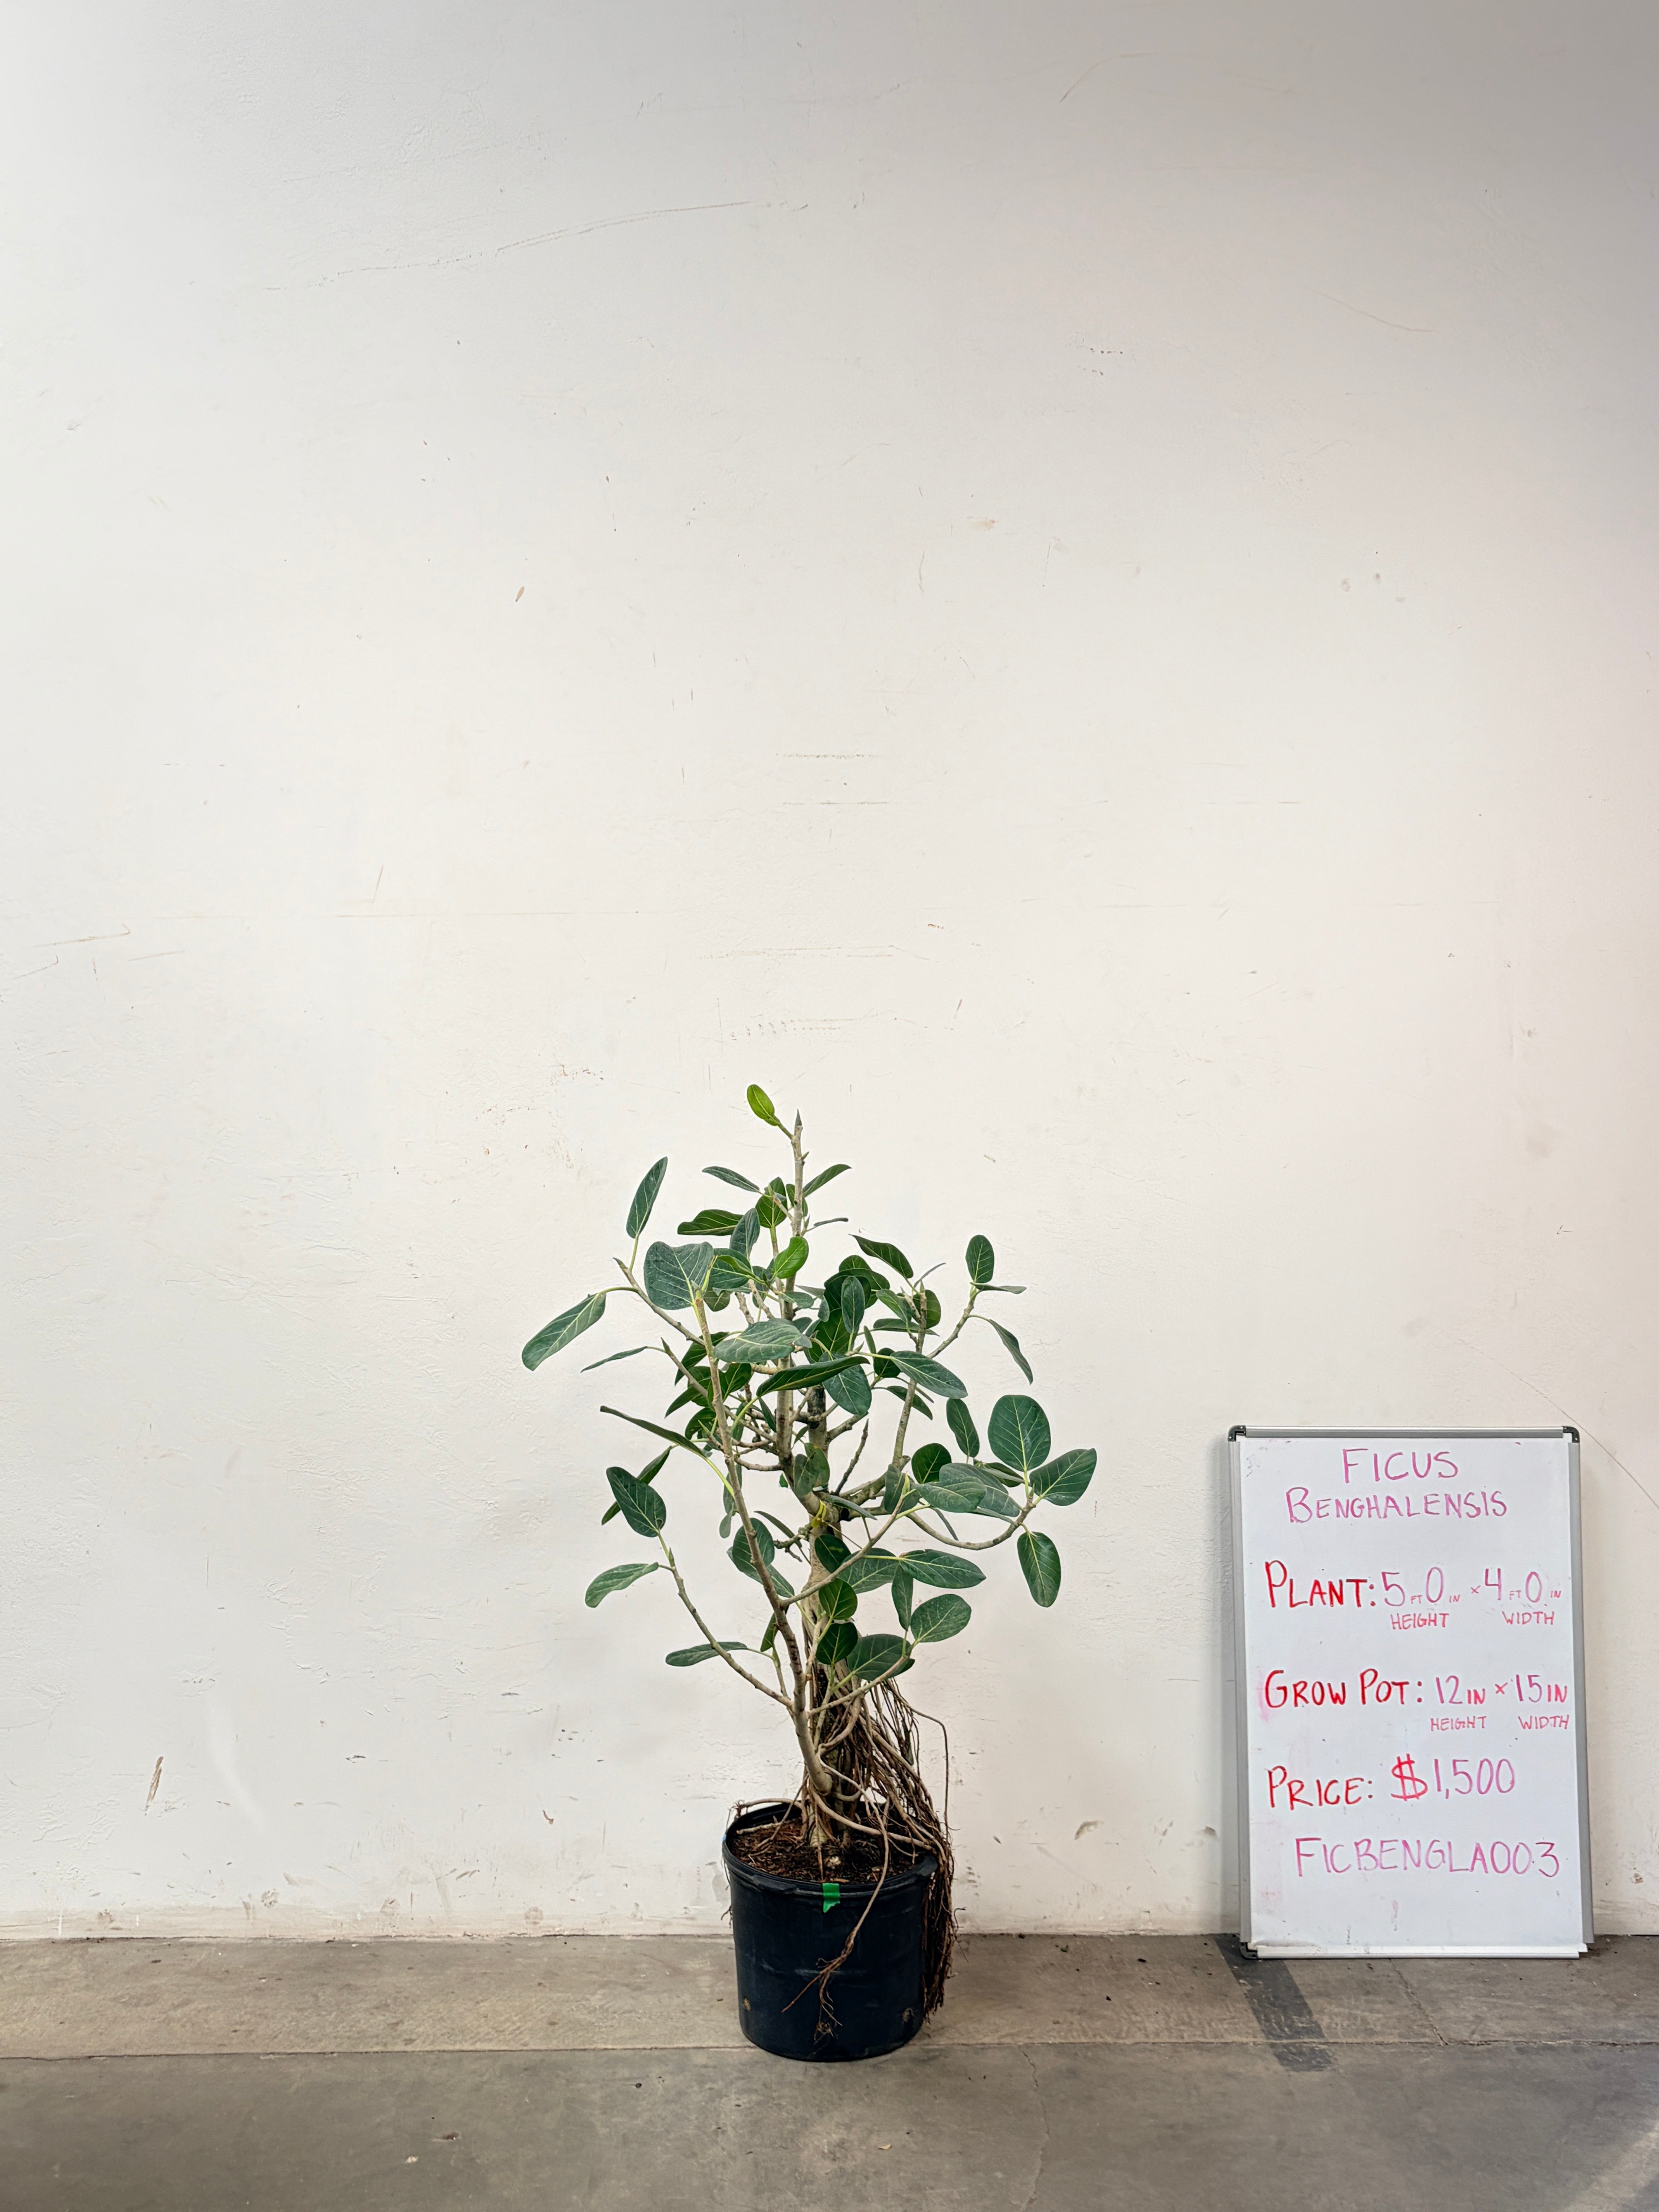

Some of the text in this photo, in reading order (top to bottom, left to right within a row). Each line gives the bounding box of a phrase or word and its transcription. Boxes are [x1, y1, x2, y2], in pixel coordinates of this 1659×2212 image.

[1342, 1448, 1458, 1483] FICUS
[1286, 1486, 1508, 1523] BENGHALENSIS
[1265, 1560, 1376, 1608] PLANT:
[1391, 1611, 1555, 1630] HEIGHT WIDTH
[1265, 1670, 1346, 1708] GROW
[1360, 1668, 1423, 1705] POT:
[1431, 1715, 1569, 1731] HEIGHT WIDTH
[1267, 1753, 1515, 1810] PRICE: $1,500
